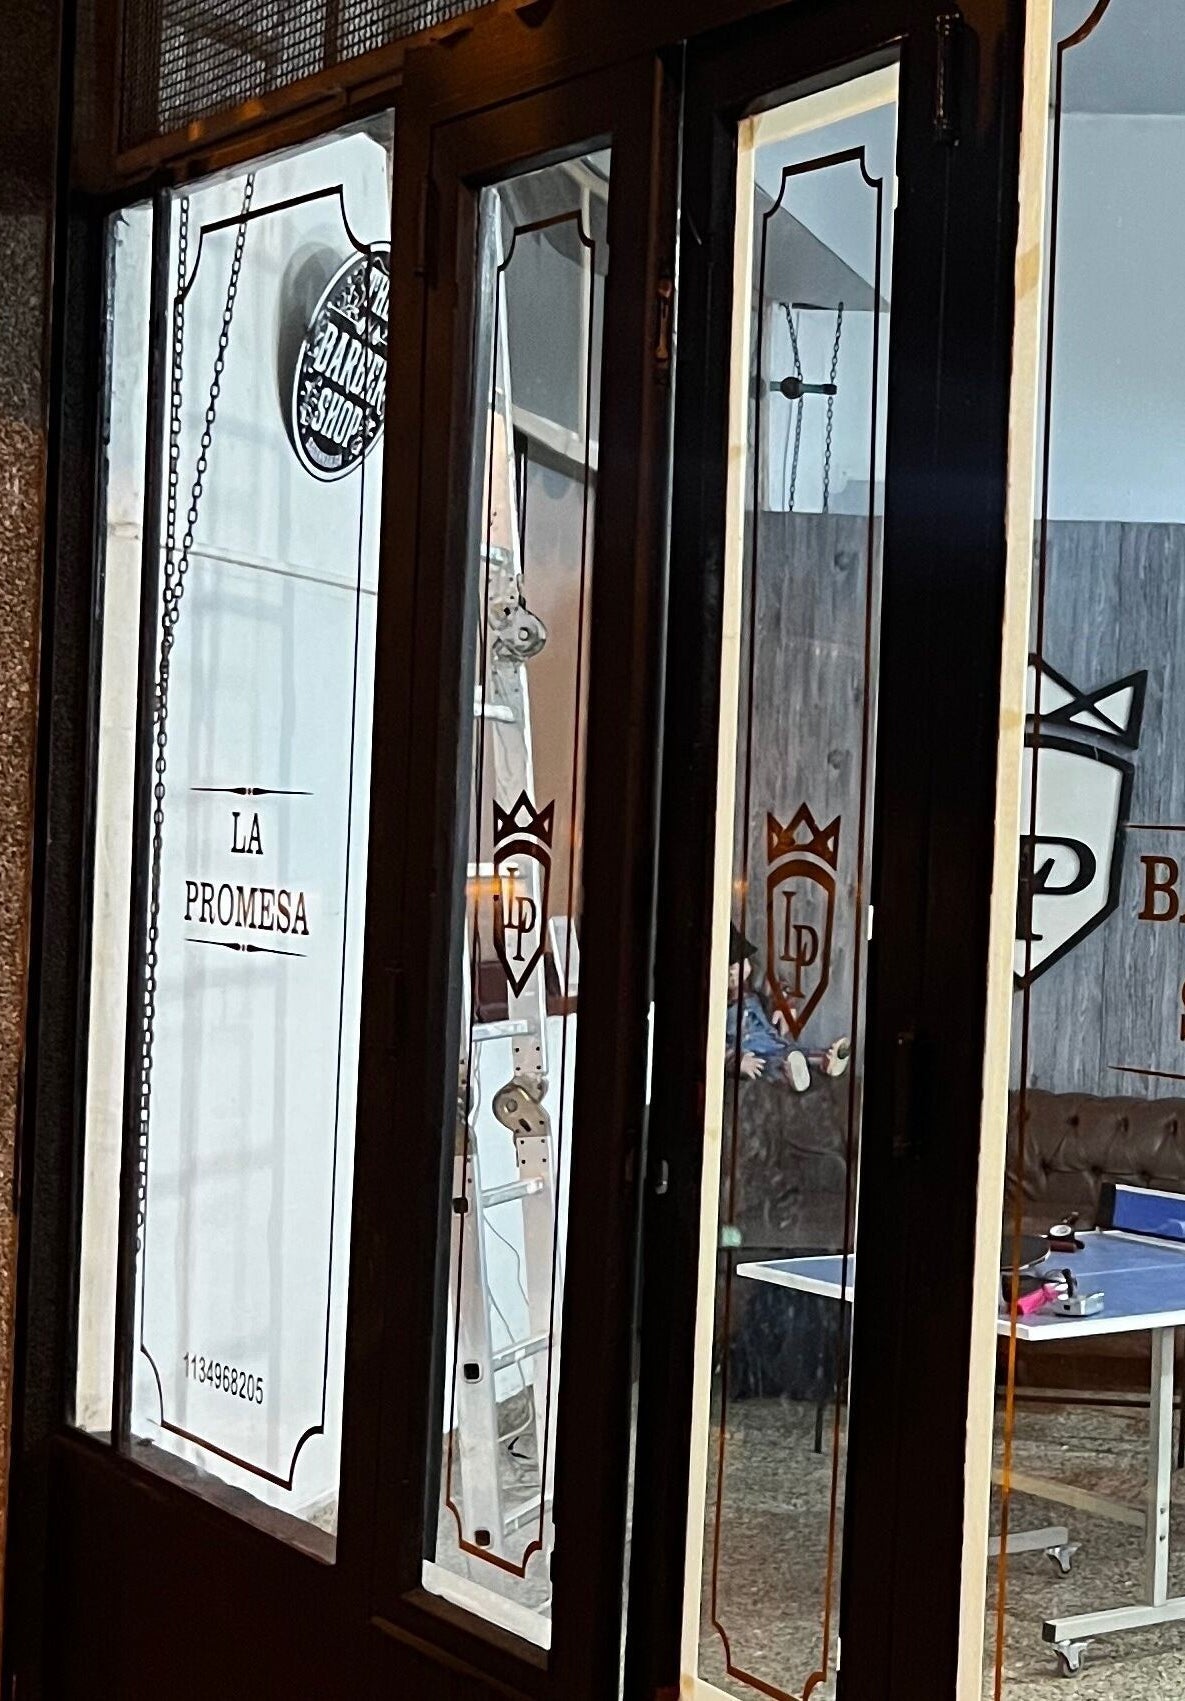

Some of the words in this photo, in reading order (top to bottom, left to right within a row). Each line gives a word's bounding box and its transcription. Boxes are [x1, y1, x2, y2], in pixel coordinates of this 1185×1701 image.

[311, 388, 363, 448] SHOP
[231, 811, 264, 855] LA
[184, 880, 310, 936] PROMESA
[183, 1351, 264, 1405] 1134968205
